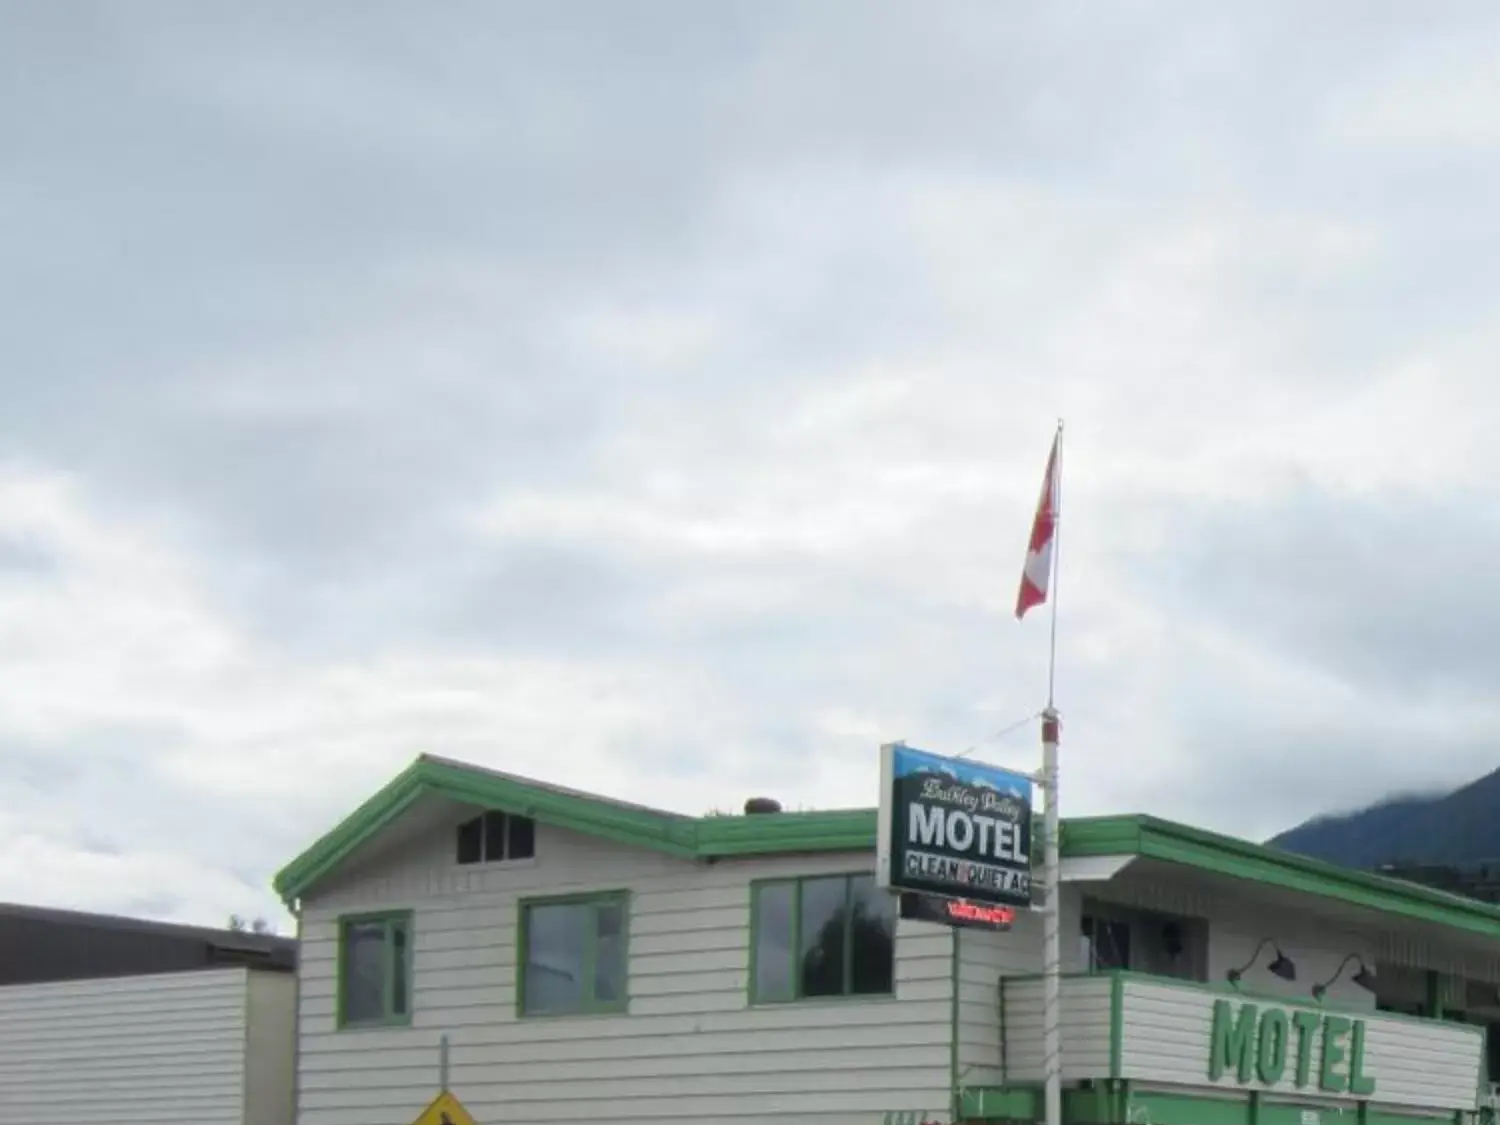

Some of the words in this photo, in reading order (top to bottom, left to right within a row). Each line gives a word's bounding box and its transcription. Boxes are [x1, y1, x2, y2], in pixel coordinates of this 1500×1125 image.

[908, 802, 1028, 864] MOTEL
[906, 853, 957, 881] CLEAN
[967, 862, 1006, 889] QUIET
[1208, 998, 1376, 1095] MOTEL
